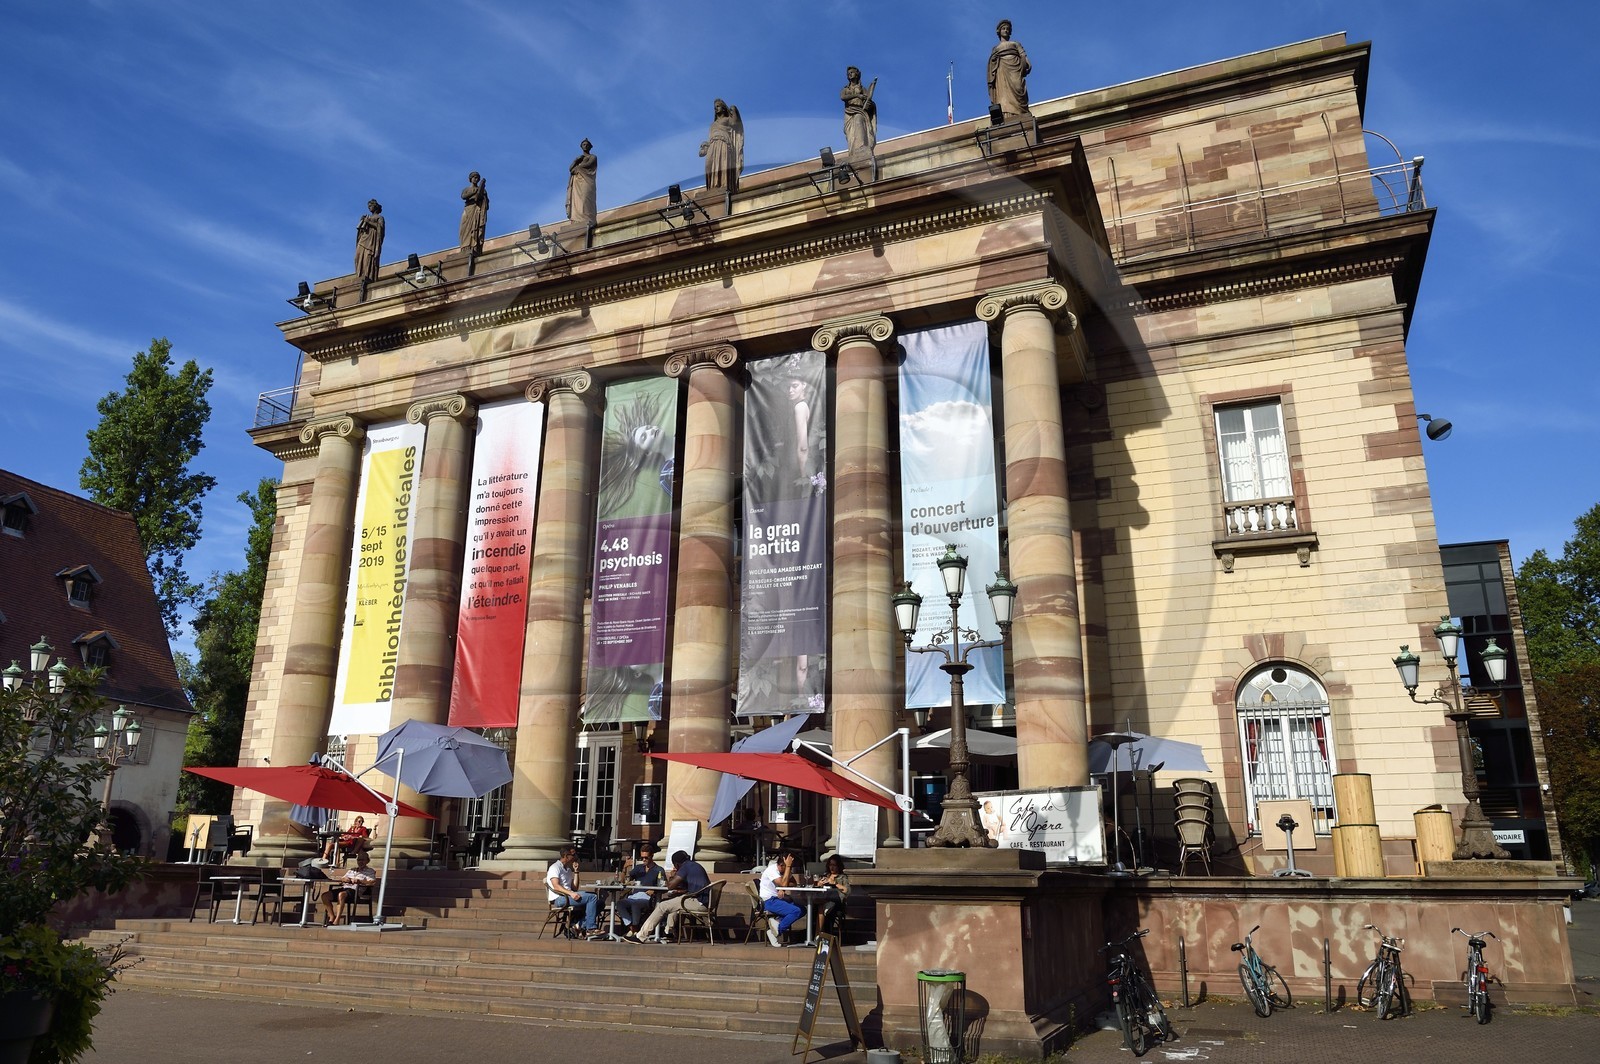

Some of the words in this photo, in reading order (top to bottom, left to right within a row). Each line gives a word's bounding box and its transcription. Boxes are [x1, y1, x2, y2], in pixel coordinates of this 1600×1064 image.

[477, 478, 487, 486] La
[488, 472, 529, 485] littérature
[476, 491, 490, 499] m'a
[491, 487, 524, 498] toujours
[475, 503, 500, 513] donné
[501, 500, 523, 510] cette
[910, 500, 966, 518] concert
[474, 515, 519, 526] impression
[910, 516, 995, 536] d'ouverture
[361, 525, 387, 539] 5/15
[473, 531, 489, 543] qu'il
[490, 532, 495, 540] y
[495, 528, 515, 537] avait
[516, 528, 527, 536] un
[749, 524, 763, 539] la
[766, 522, 800, 541] gran
[360, 540, 383, 553] sept
[472, 543, 526, 560] incendie
[600, 537, 629, 552] 4.48
[749, 538, 800, 559] partita
[358, 555, 385, 568] 2019
[599, 551, 663, 573] psychosis
[376, 535, 407, 703] bibliothèques
[393, 445, 416, 528] idéales
[471, 564, 502, 575] quelque
[502, 563, 520, 573] part,
[748, 567, 777, 575] WOLFGANG
[778, 565, 802, 573] AMADEUS
[802, 563, 823, 571] MOZART
[478, 580, 492, 589] qu'il
[493, 580, 504, 588] me
[505, 576, 524, 586] fallait
[467, 592, 522, 609] l'éteindre.
[1009, 797, 1035, 820] Café
[1041, 800, 1054, 811] de
[1493, 833, 1522, 841] ONDAIRE
